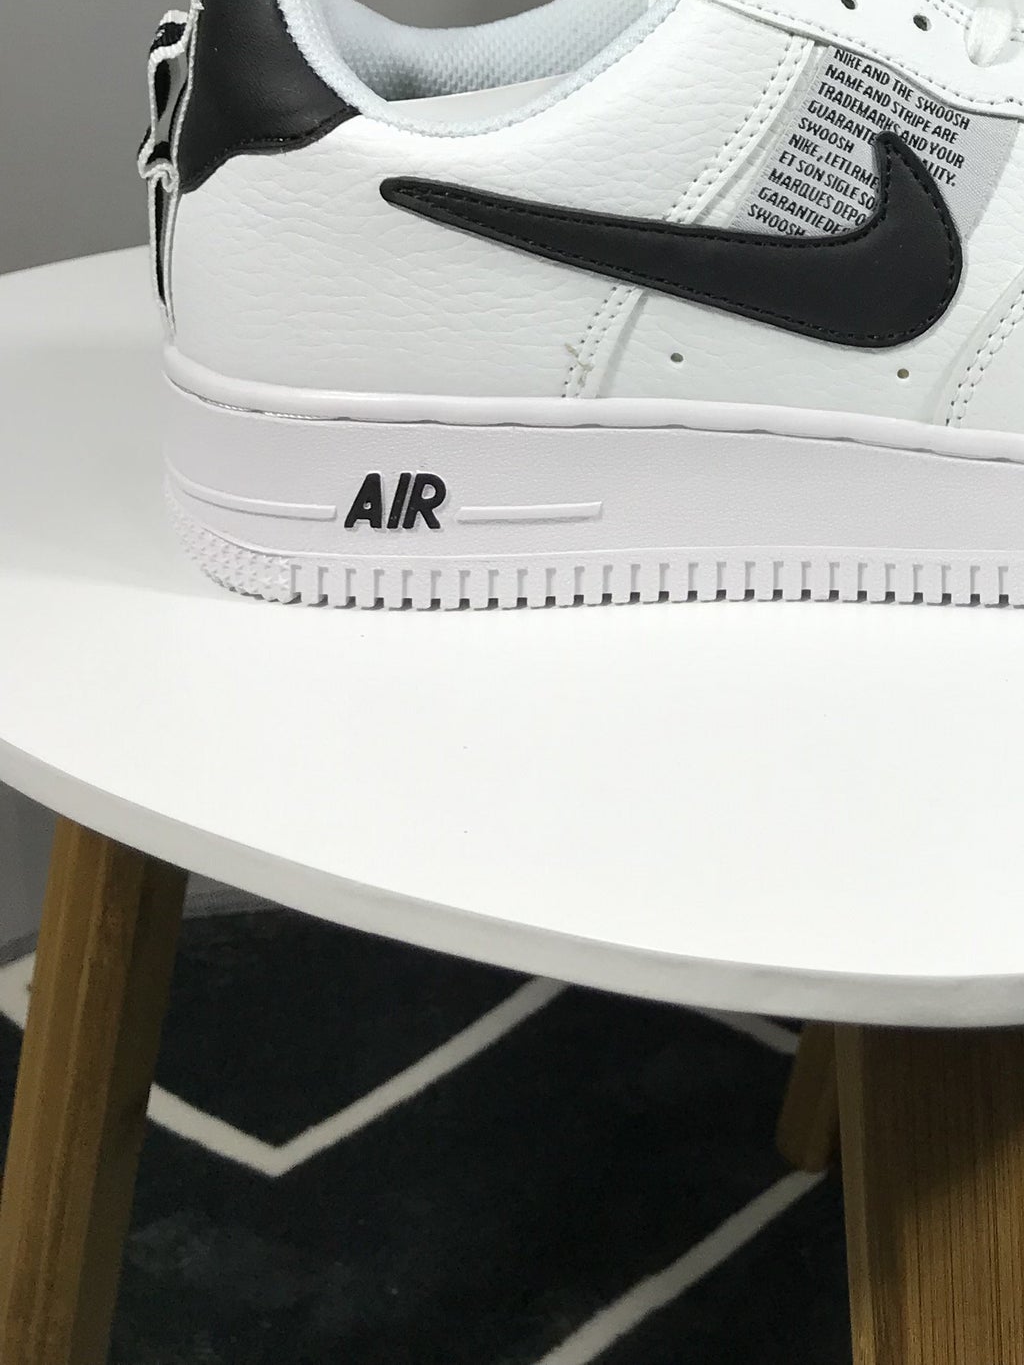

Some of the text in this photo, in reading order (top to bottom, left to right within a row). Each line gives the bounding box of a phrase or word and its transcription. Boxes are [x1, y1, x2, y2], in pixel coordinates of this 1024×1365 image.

[825, 64, 959, 144] NAME AND STRIPE ARE
[833, 48, 970, 130] NIKE AND THE SWOOSH
[798, 117, 855, 154] SWOOSH
[807, 100, 878, 146] GUARANTE
[817, 82, 965, 169] TRADEMARKS AND YOUR
[757, 187, 827, 229] GARANTIE
[768, 168, 867, 227] MARQUES DEPO
[779, 150, 876, 211] ET SON SIGLE SO
[748, 203, 806, 236] SWOOSH
[344, 472, 447, 530] AIR
